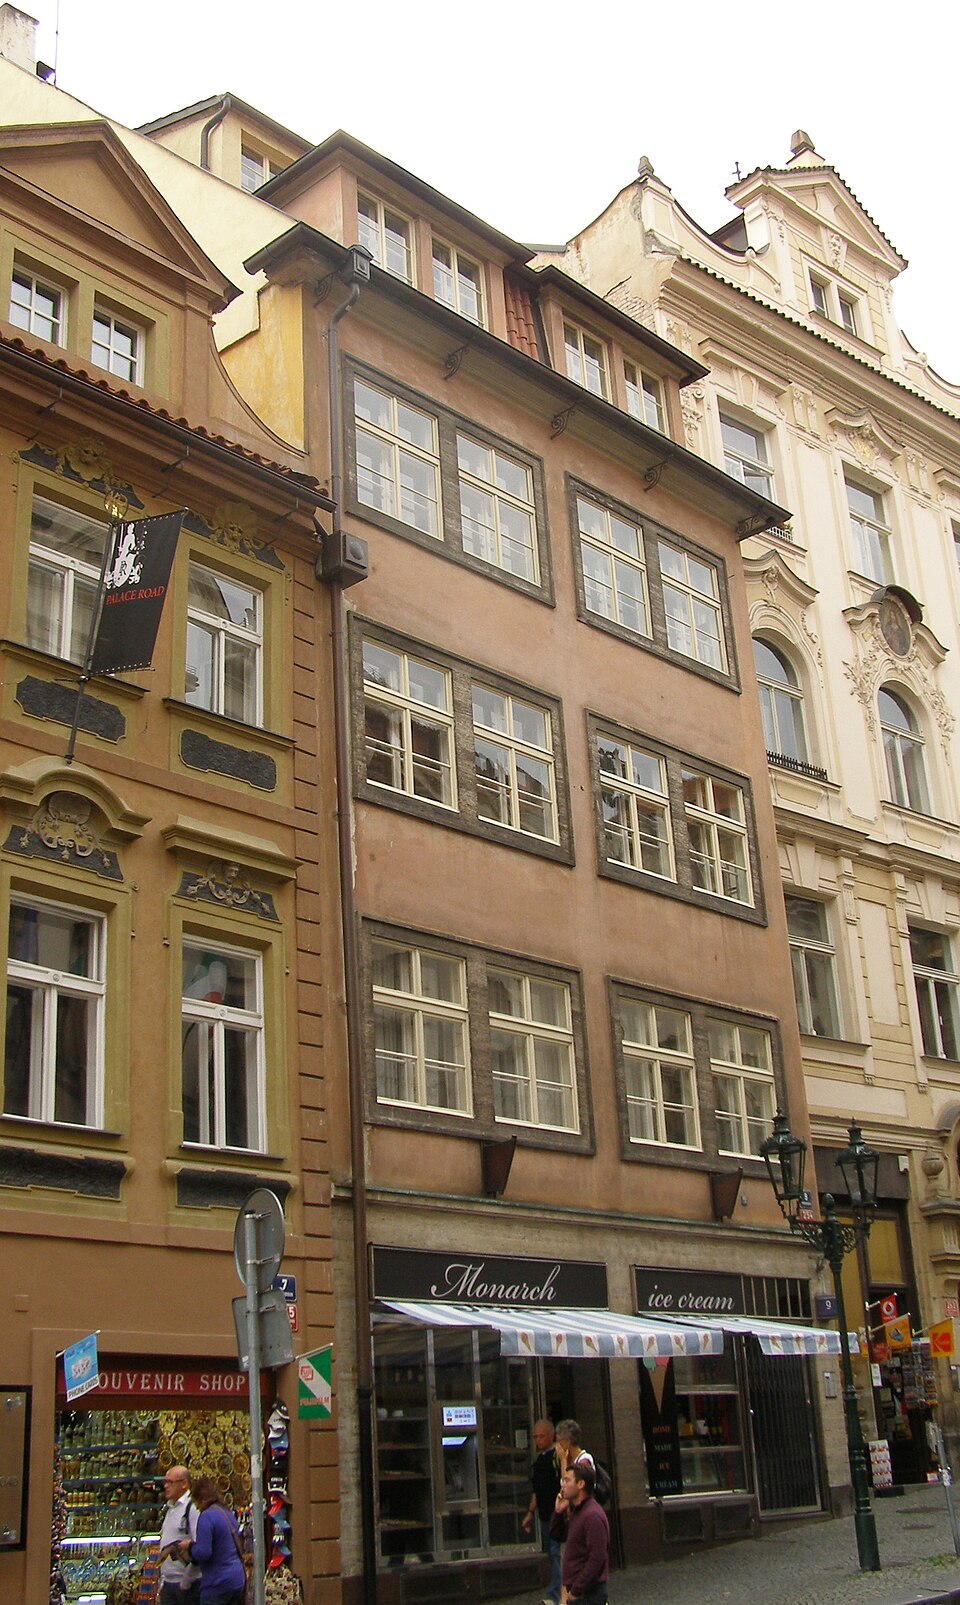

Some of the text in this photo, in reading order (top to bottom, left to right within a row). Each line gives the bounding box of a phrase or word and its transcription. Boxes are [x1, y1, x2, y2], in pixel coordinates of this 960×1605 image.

[105, 585, 165, 605] PALACE ROAD
[281, 1279, 288, 1291] 7
[430, 1262, 561, 1300] Monarch
[648, 1284, 736, 1310] ice cream
[825, 1299, 832, 1310] 9
[97, 1372, 246, 1392] OUVENIR SHOP
